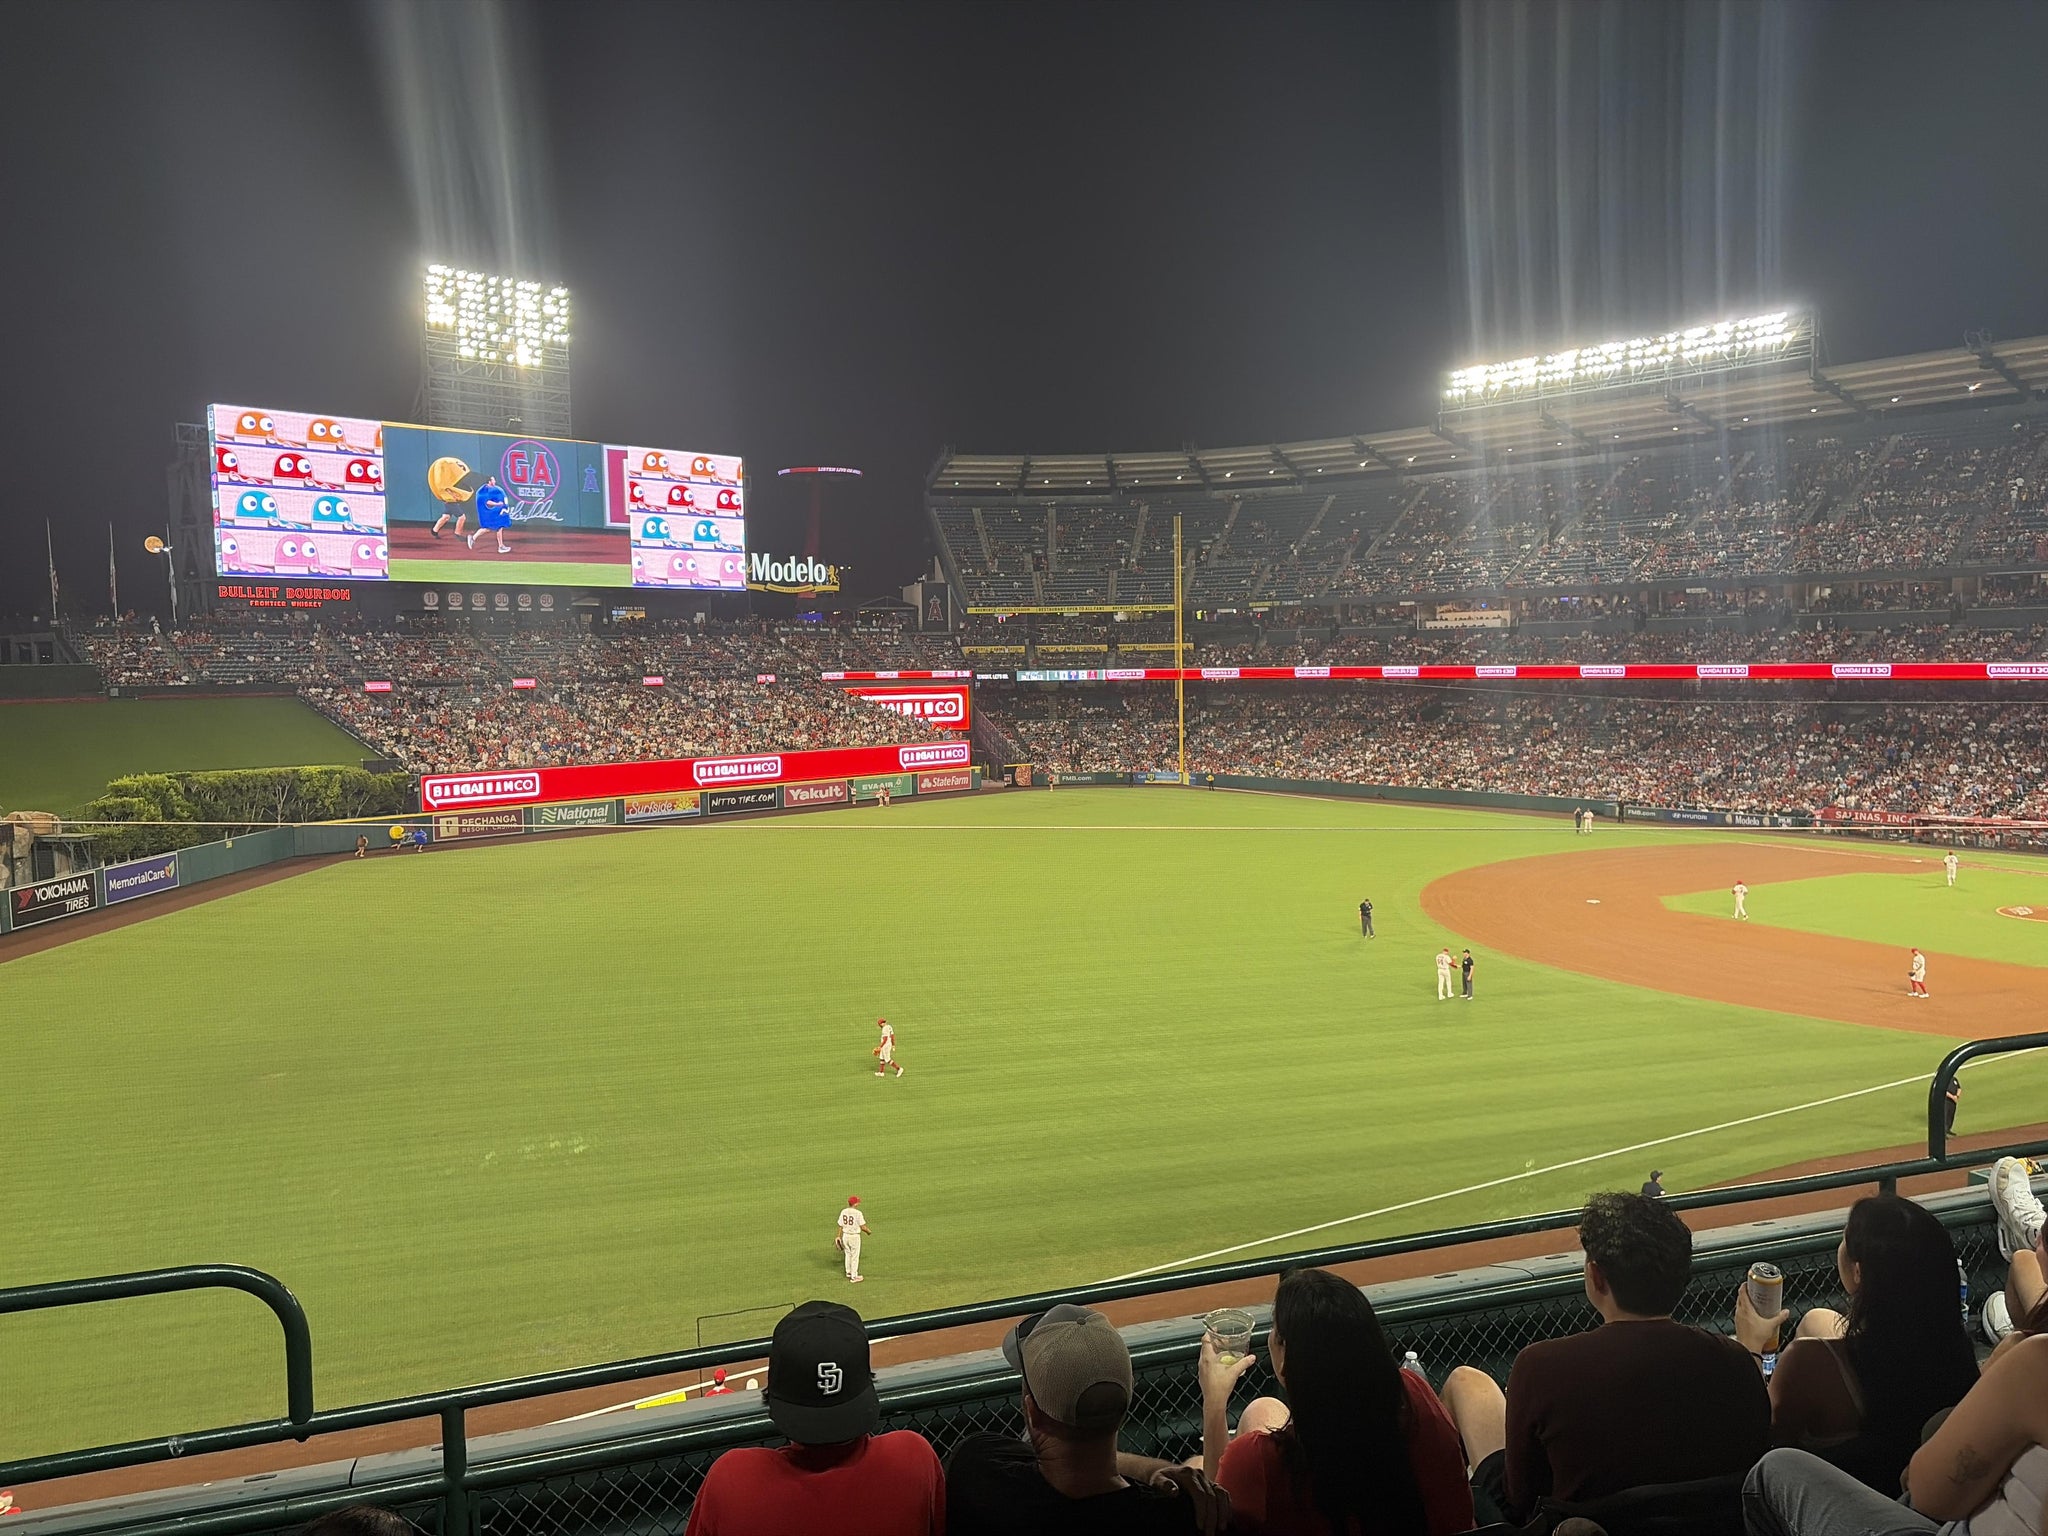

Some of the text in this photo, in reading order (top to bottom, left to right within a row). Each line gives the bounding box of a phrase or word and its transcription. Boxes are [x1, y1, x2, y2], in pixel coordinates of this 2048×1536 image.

[751, 553, 826, 582] Modelo
[218, 585, 350, 601] BULLEIT BOURBON
[711, 792, 775, 807] NITTO TIRE.COM
[789, 785, 844, 801] Yakult
[557, 805, 609, 820] National
[629, 801, 673, 816] Surfside
[461, 814, 517, 826] PECHANGA
[1735, 816, 1760, 826] Modelo
[109, 869, 165, 891] MemorialCare
[35, 878, 88, 902] YOKOHAMA
[65, 897, 89, 912] TIRES
[817, 1362, 843, 1395] SD
